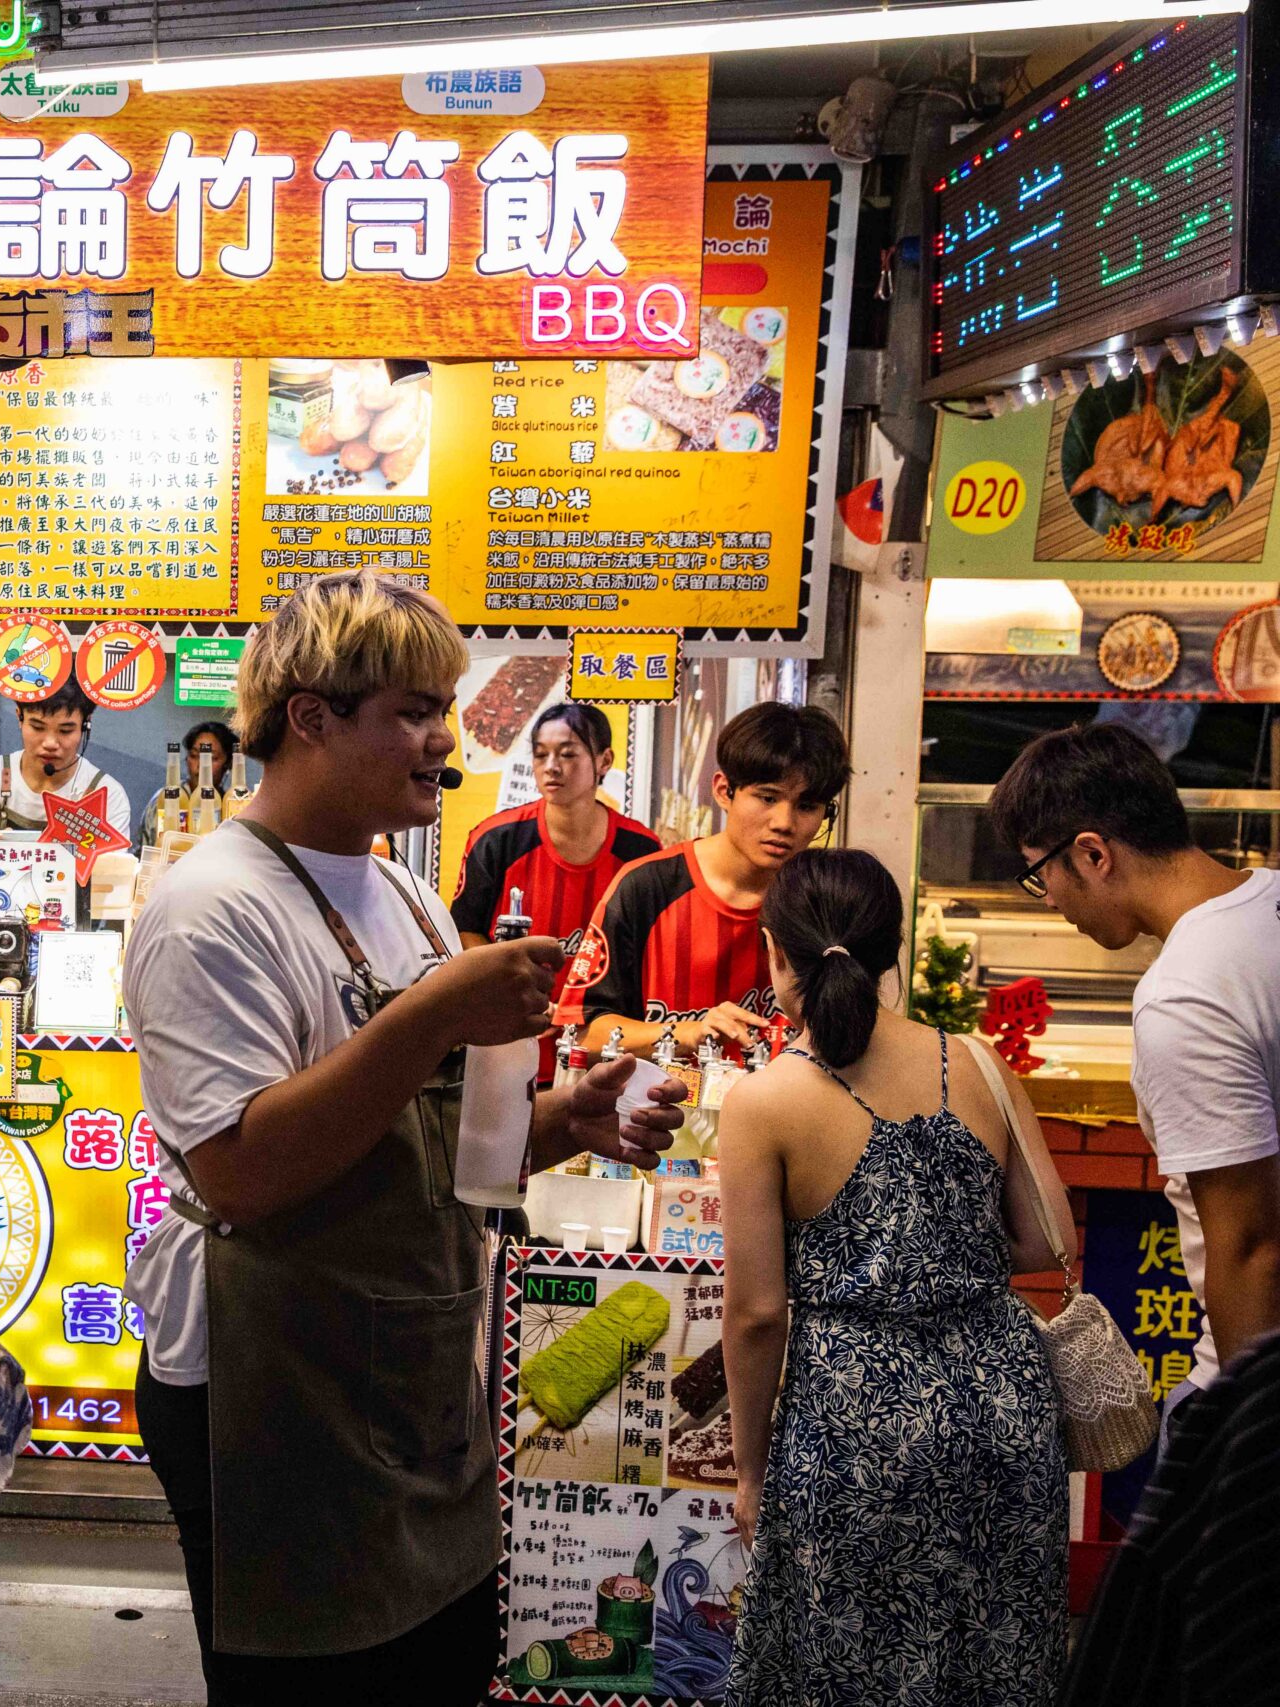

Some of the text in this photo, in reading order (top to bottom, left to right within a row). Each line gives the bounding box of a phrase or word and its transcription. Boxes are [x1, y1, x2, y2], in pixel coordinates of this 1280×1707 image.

[425, 69, 522, 94] 布農族語
[445, 96, 493, 110] Bunun
[528, 282, 692, 347] BBQ
[493, 376, 564, 388] Red rice
[492, 395, 595, 418] 紫米
[492, 421, 598, 432] Black glutinous rice
[491, 441, 595, 463] 紅藜
[490, 467, 680, 479] Taiwan aboriginal red quinoa
[489, 487, 591, 509] 台灣小米
[951, 478, 1019, 518] D20
[263, 504, 431, 522] 嚴選花蓮在地的山胡椒
[488, 512, 590, 523] Taiwan Millet
[262, 551, 430, 568] 粉均勻灑在手工香腸上
[579, 653, 668, 680] 取餐區
[98, 697, 110, 705] not
[110, 699, 134, 708] collect
[9, 1104, 53, 1120] 台灣豬
[26, 1122, 49, 1136] PORK
[526, 1278, 597, 1304] NT:50
[37, 1397, 122, 1424] 1462
[622, 1342, 647, 1485] 抹茶烤麻糬
[643, 1351, 667, 1458] 濃郁清香
[521, 1435, 566, 1453] 小確幸
[516, 1480, 613, 1516] 竹筒飯
